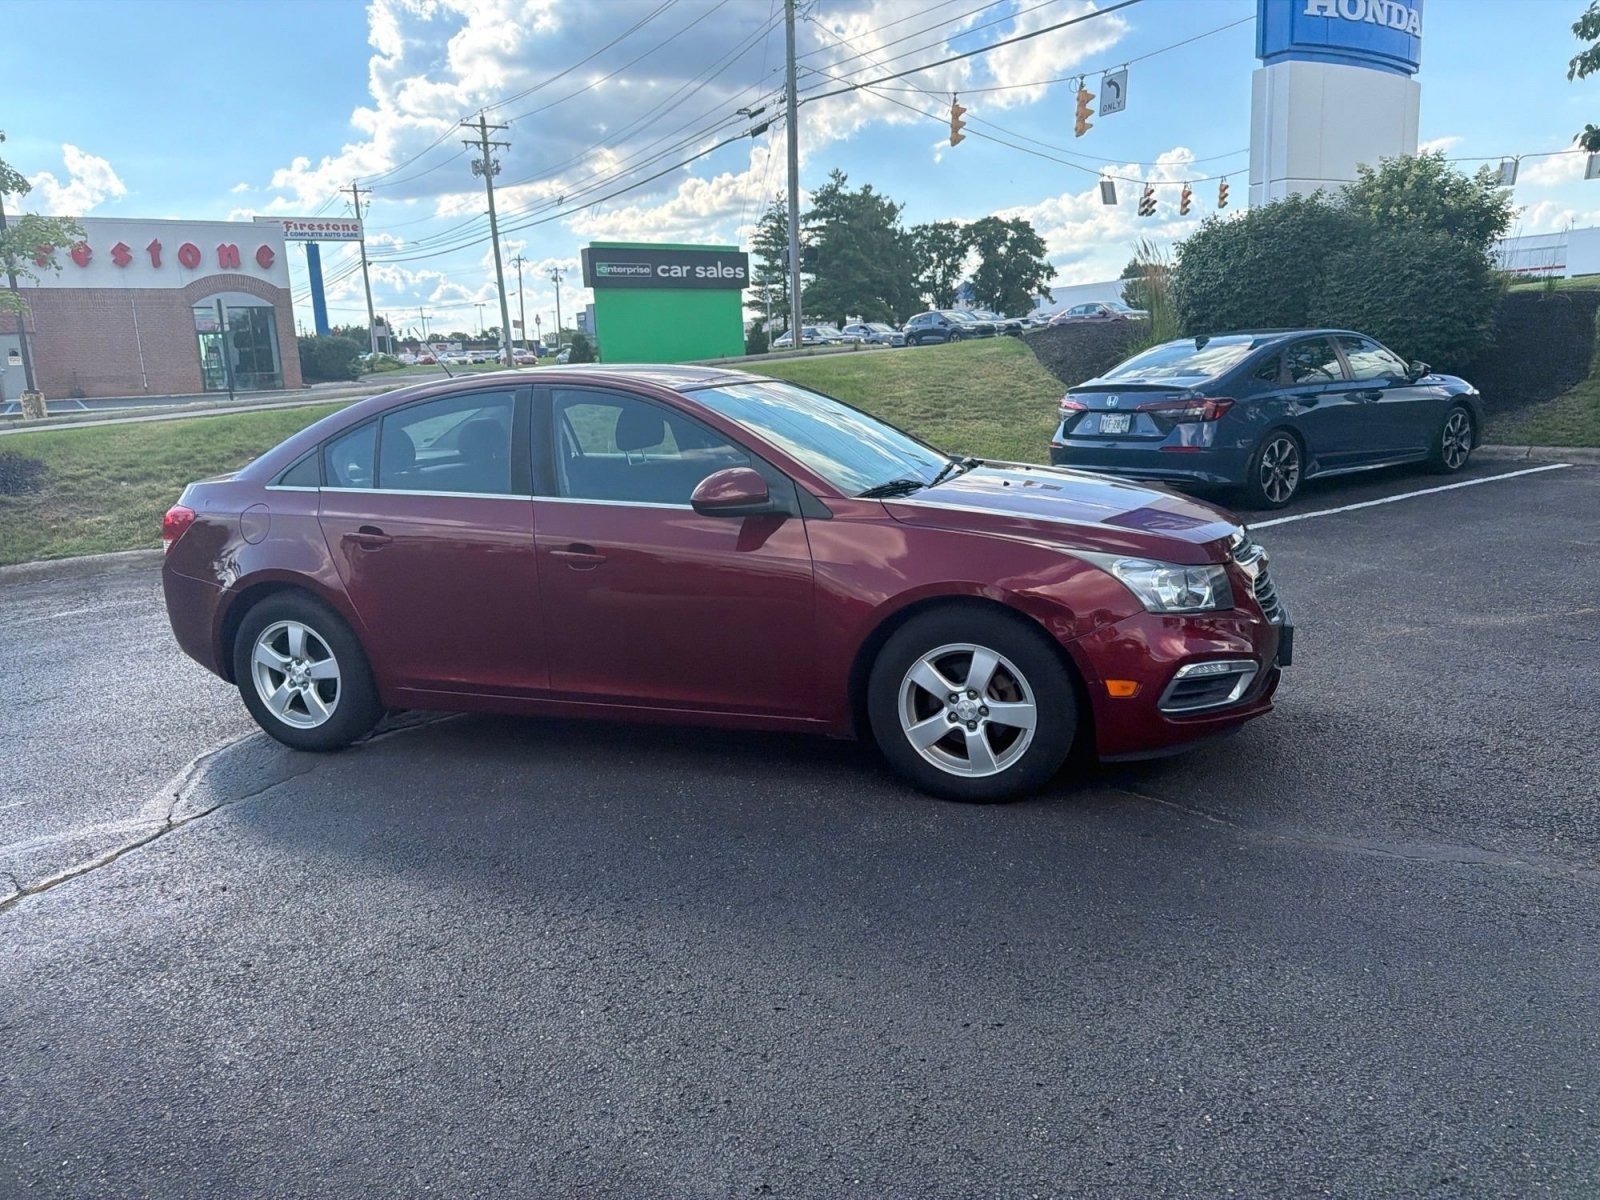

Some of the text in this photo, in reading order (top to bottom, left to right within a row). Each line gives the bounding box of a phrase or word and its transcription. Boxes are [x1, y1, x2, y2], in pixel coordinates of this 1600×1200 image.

[1304, 0, 1422, 39] HONDA
[1102, 100, 1122, 112] ONLY
[283, 220, 359, 231] Firestone
[597, 261, 745, 278] enterprise car sales
